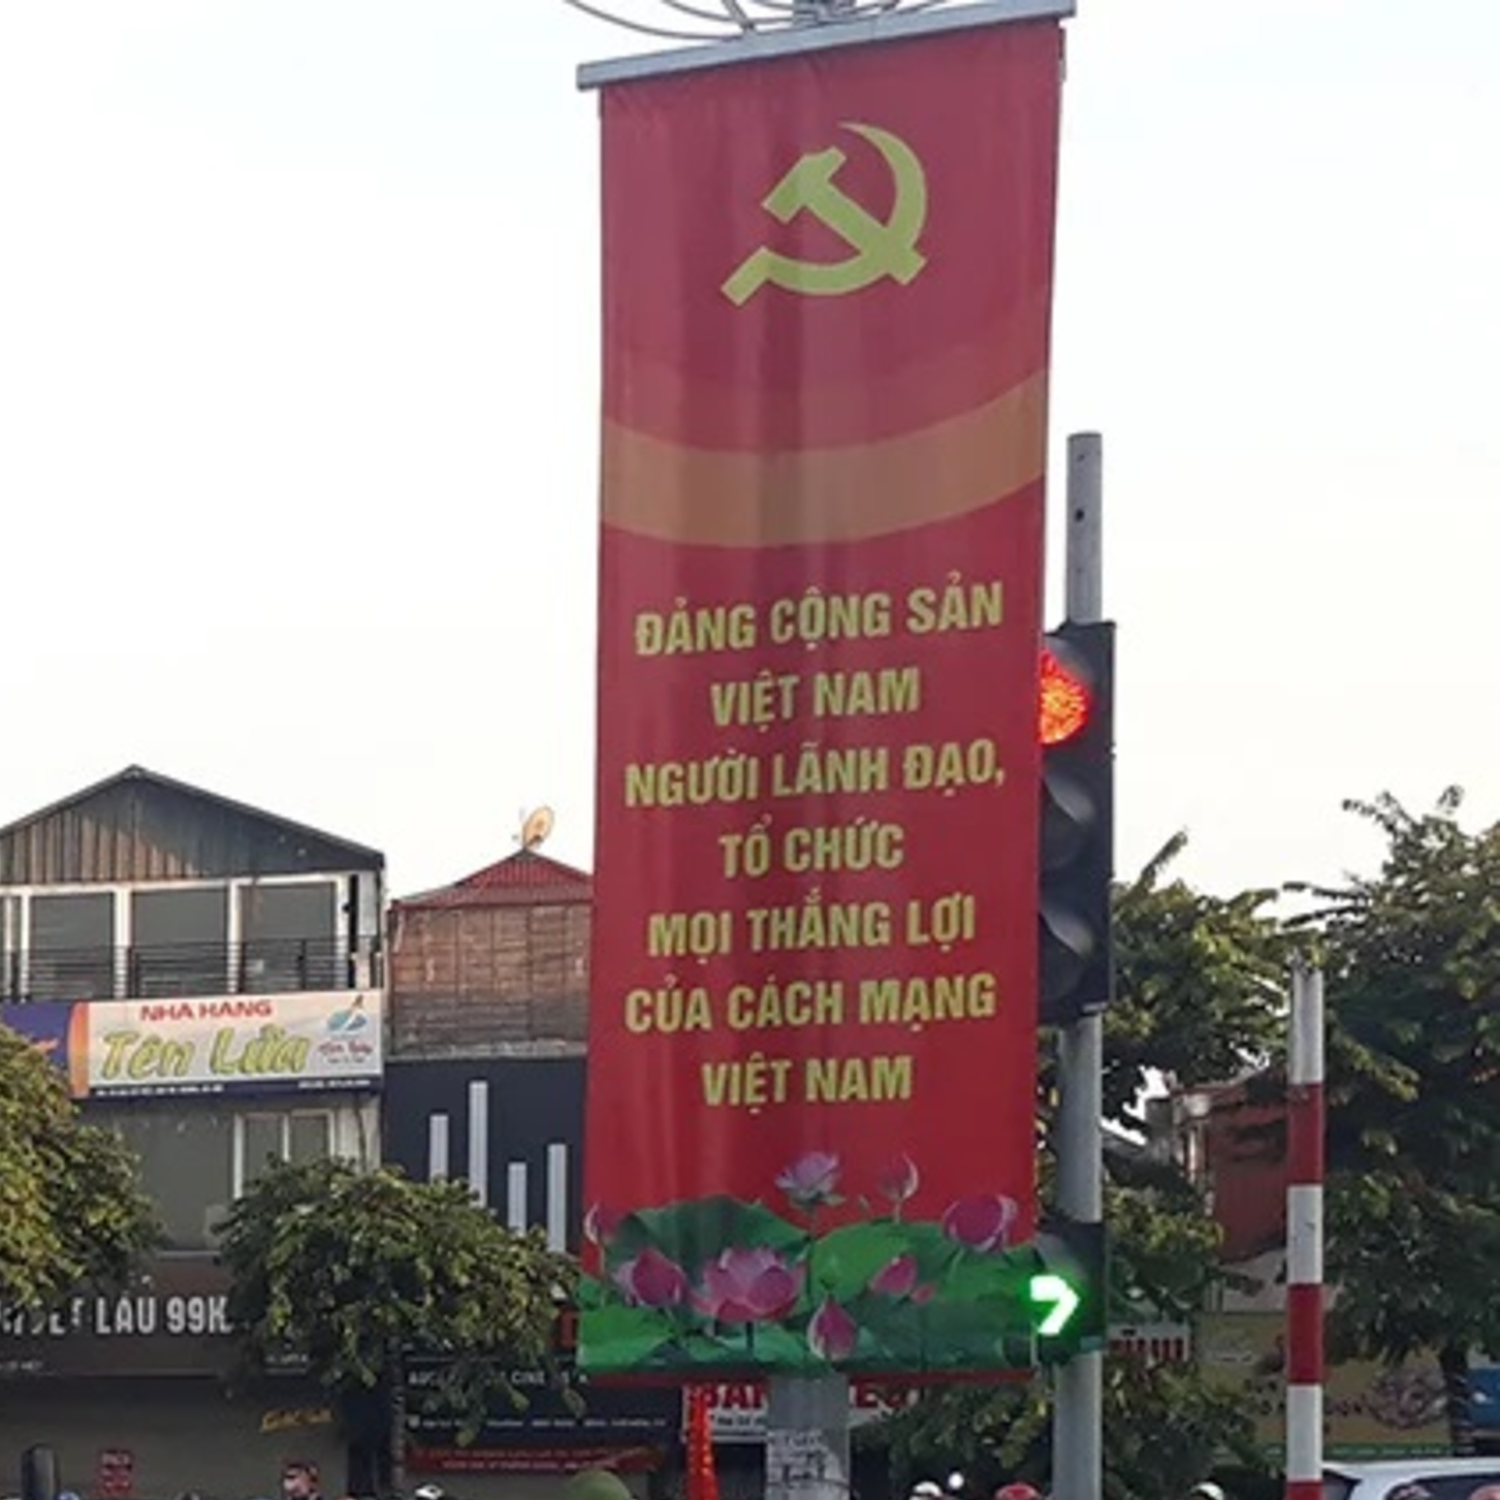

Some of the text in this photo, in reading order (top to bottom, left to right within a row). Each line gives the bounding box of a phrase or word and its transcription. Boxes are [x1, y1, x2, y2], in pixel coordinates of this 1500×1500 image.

[635, 571, 1003, 656] ĐẢNG CỘNG SẢN
[711, 667, 921, 733] VIỆT NAM
[625, 738, 1006, 808] NGƯỜI LÃNH ĐẠO,
[719, 814, 905, 879] TỔ CHỨC
[649, 887, 976, 964] MỌI THẮNG LỢI
[625, 972, 997, 1033] CỦA CÁCH MẠNG
[702, 1053, 914, 1114] VIỆT NAM
[166, 1296, 231, 1334] 99K
